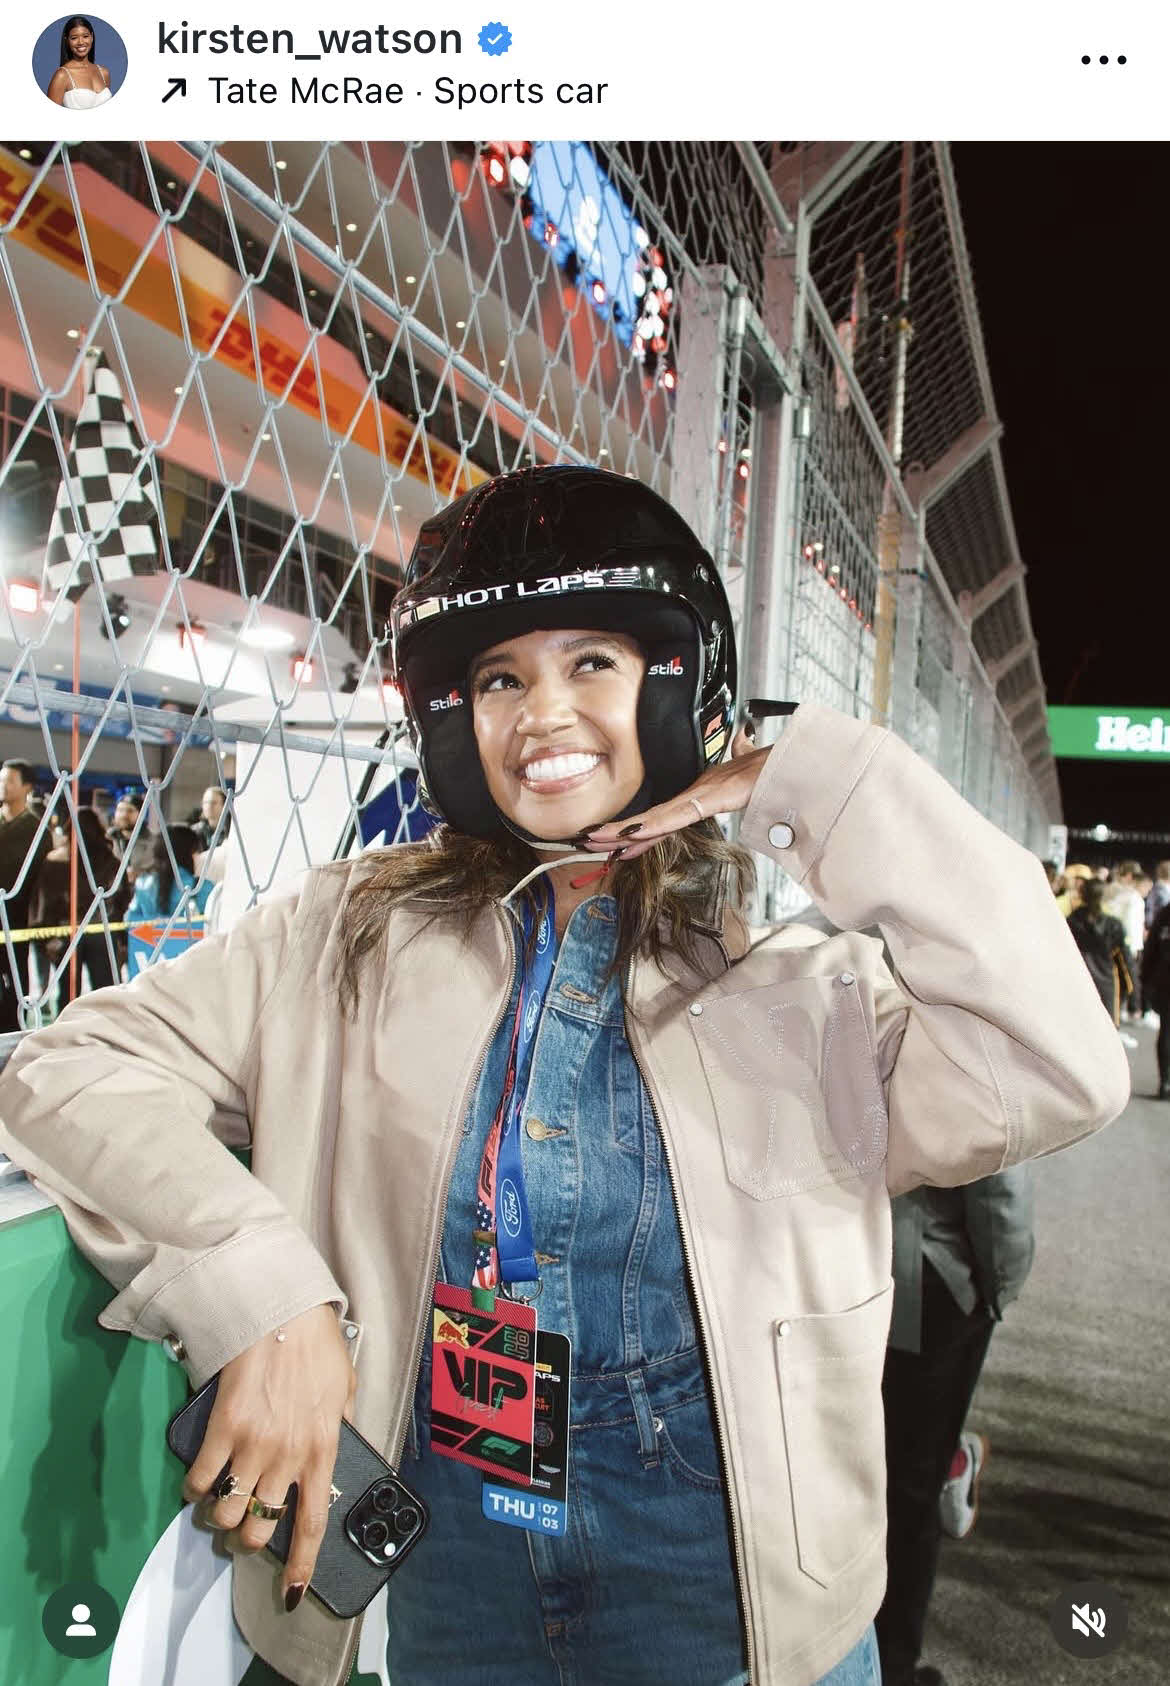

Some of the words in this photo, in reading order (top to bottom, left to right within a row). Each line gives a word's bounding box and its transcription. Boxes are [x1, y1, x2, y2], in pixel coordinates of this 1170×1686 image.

[442, 584, 510, 611] HOT
[1095, 715, 1170, 752] Hei
[442, 1348, 528, 1410] VIP
[535, 1372, 561, 1383] APS
[488, 1492, 535, 1520] THU
[542, 1503, 559, 1516] 07
[542, 1517, 559, 1530] 03
